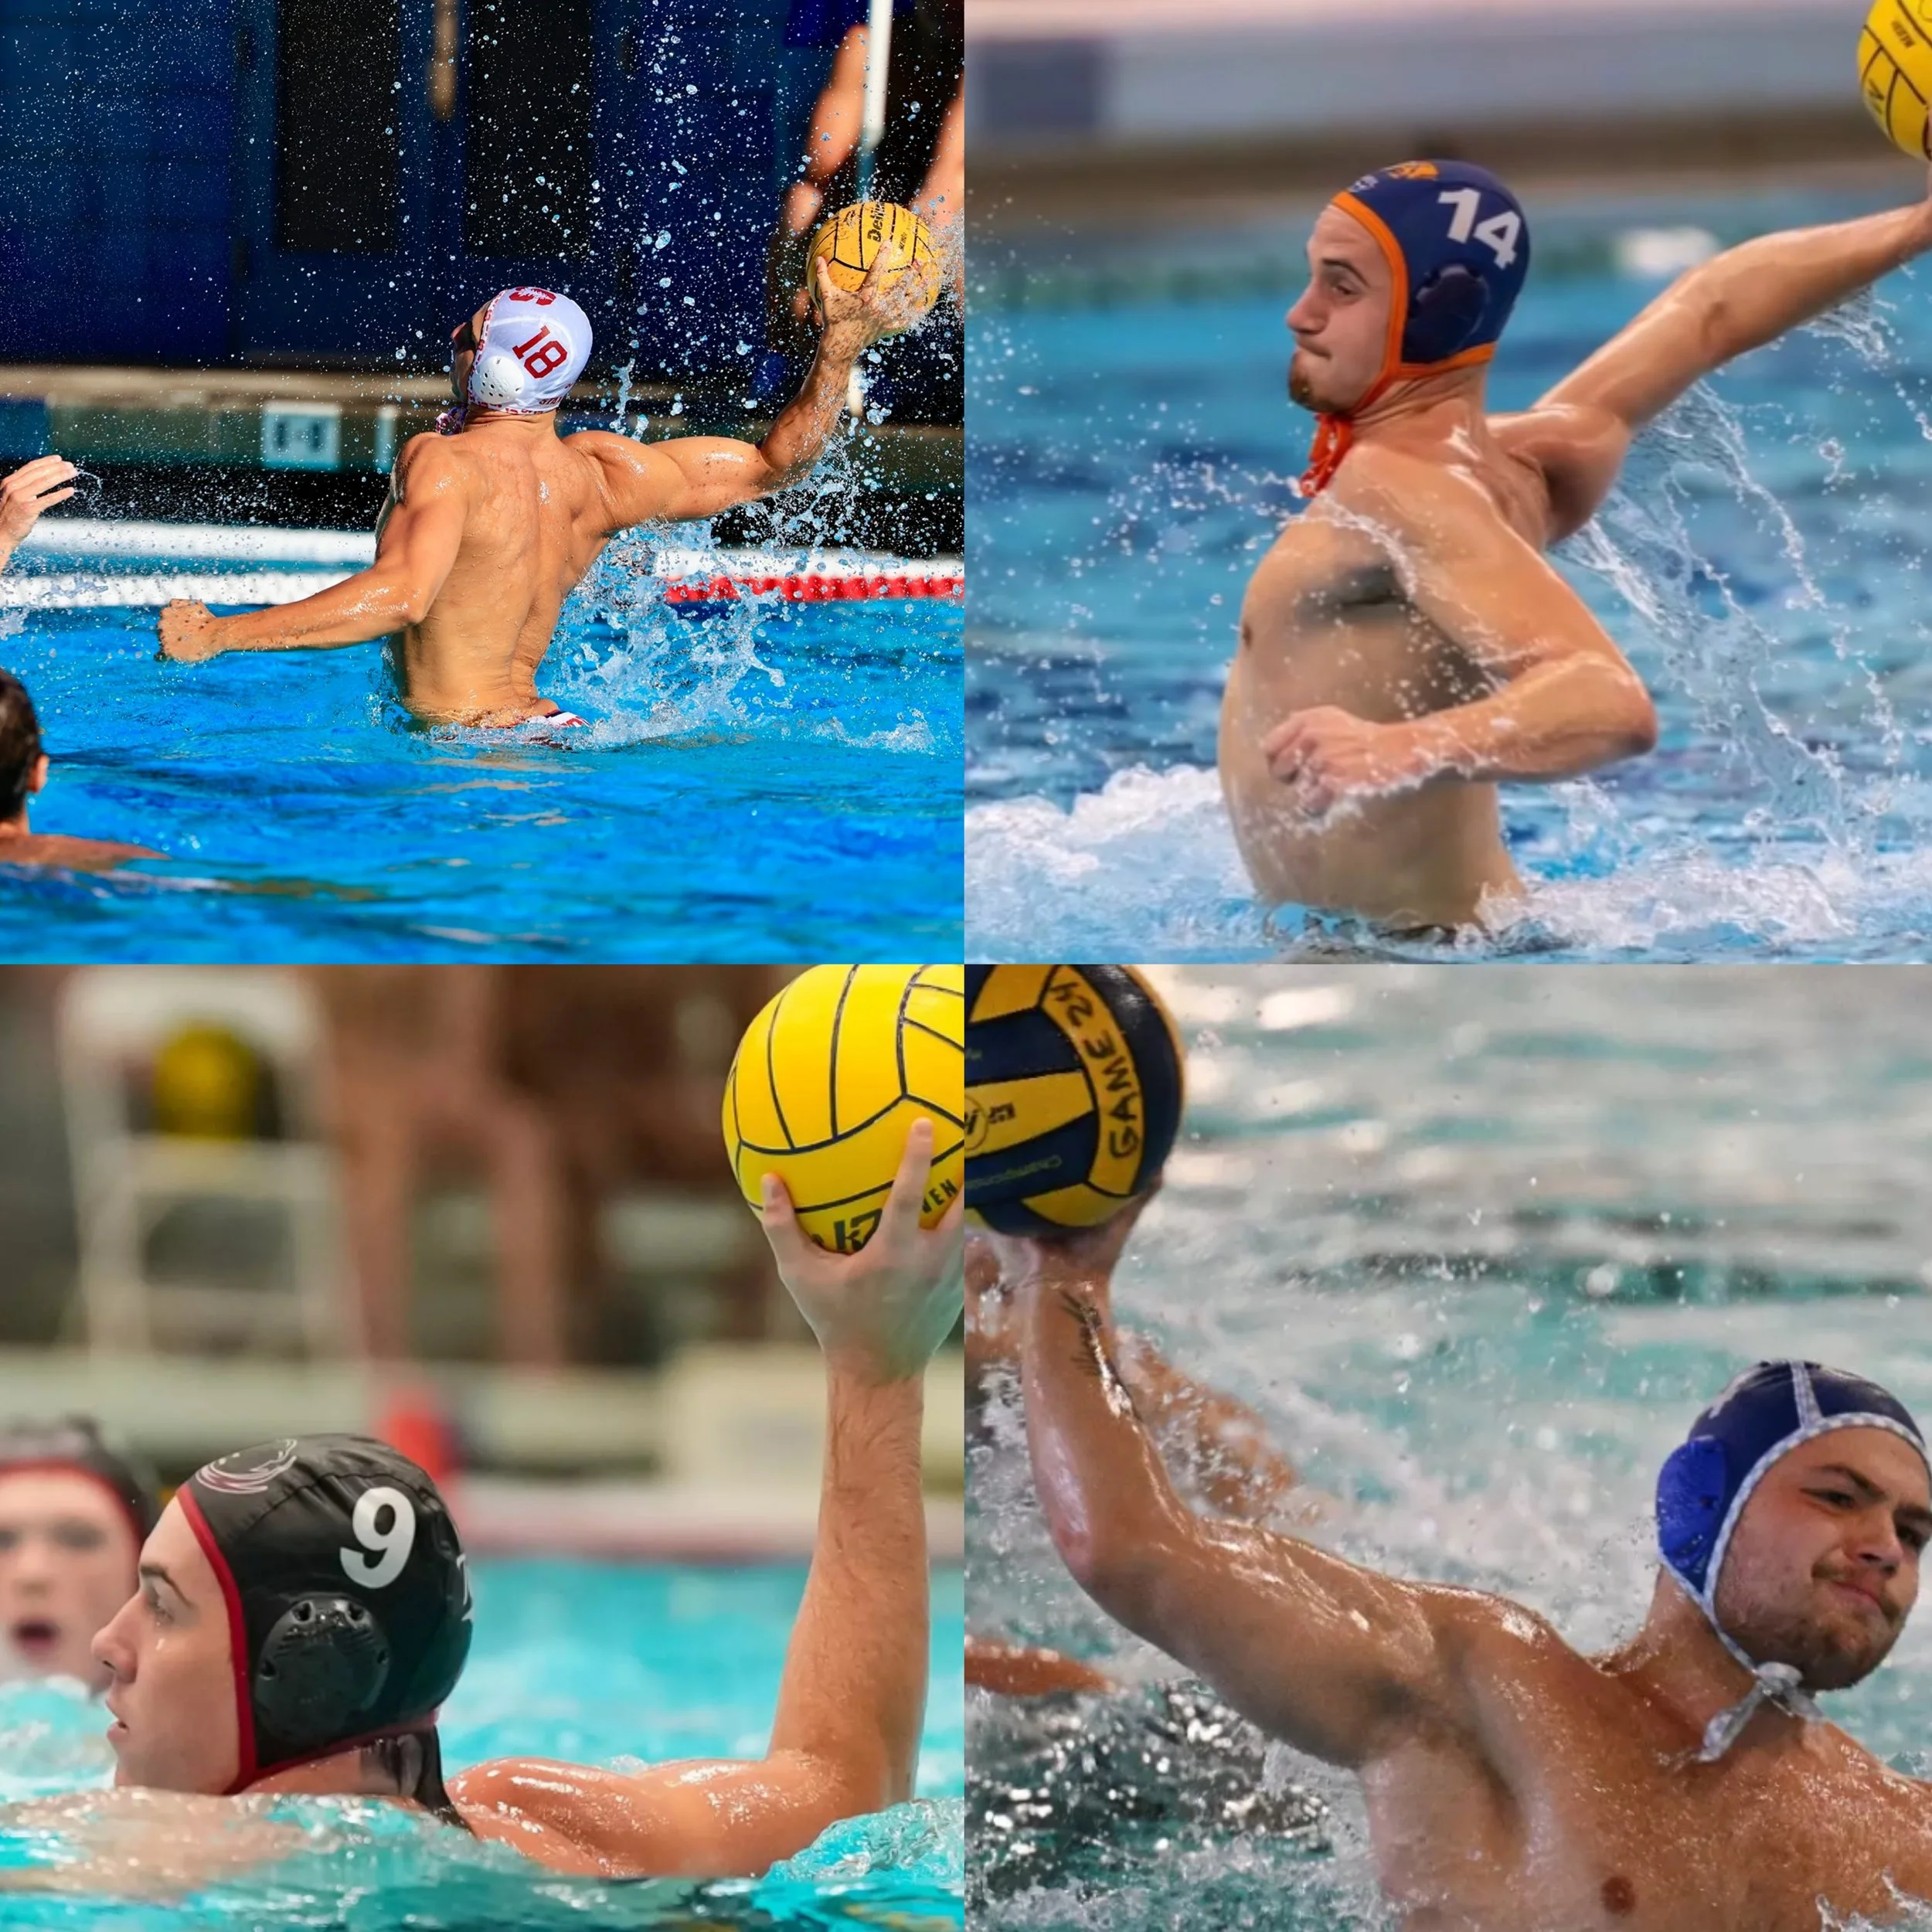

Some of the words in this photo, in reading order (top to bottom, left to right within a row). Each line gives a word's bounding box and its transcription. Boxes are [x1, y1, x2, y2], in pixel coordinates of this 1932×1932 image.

[1437, 187, 1521, 270] 14
[512, 325, 568, 379] 18
[1083, 1029, 1140, 1158] GAME
[339, 1486, 417, 1590] 9
